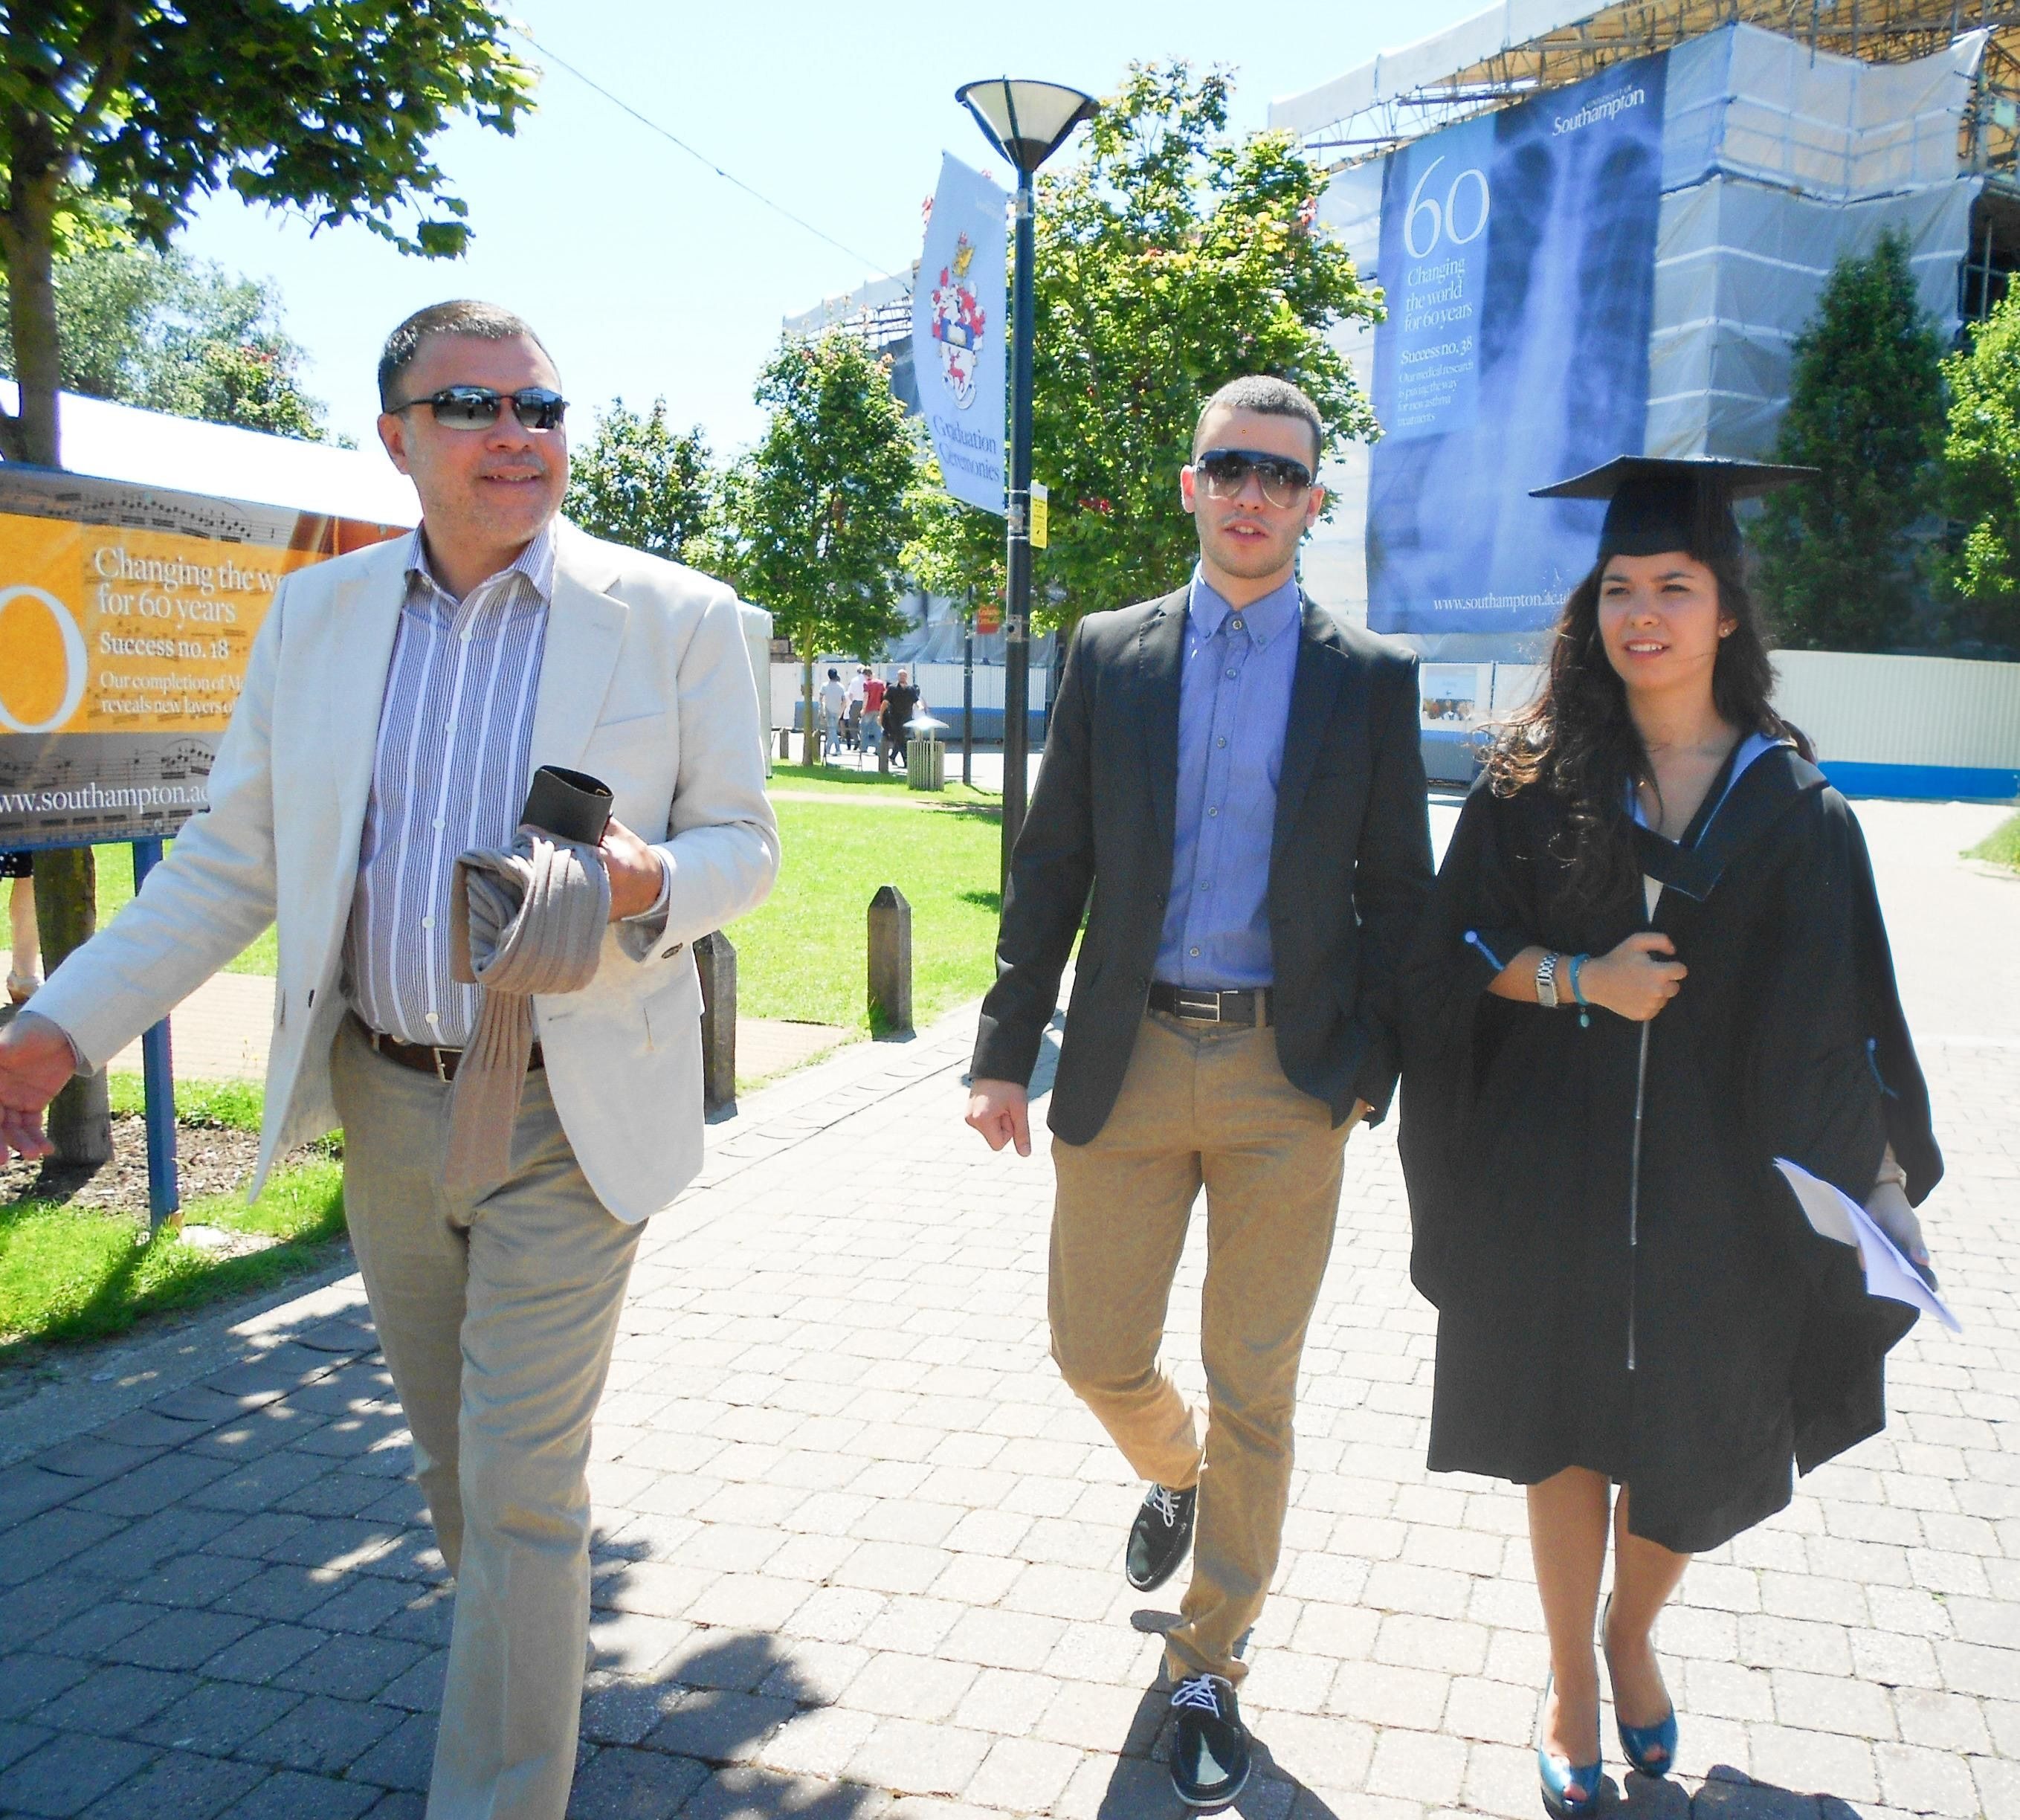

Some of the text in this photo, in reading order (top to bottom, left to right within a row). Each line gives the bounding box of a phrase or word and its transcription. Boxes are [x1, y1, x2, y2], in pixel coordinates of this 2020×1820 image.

[1552, 88, 1645, 136] Southampton
[1403, 155, 1491, 259] 60
[1407, 258, 1466, 287] Changing
[1406, 279, 1463, 312] the world
[1404, 301, 1474, 332] for 60 years
[1400, 335, 1473, 365] Success no. 38
[932, 415, 997, 454] Graduation
[938, 442, 1000, 483] Ceremonies
[94, 546, 216, 596] Changing
[217, 559, 254, 591] the
[97, 582, 237, 630] for 60 years
[100, 631, 230, 659] Success no. 18
[100, 671, 131, 688] Our
[132, 671, 210, 695] completion
[210, 674, 226, 690] of
[100, 695, 151, 714] reveals
[153, 699, 181, 714] new
[183, 695, 222, 720] layers
